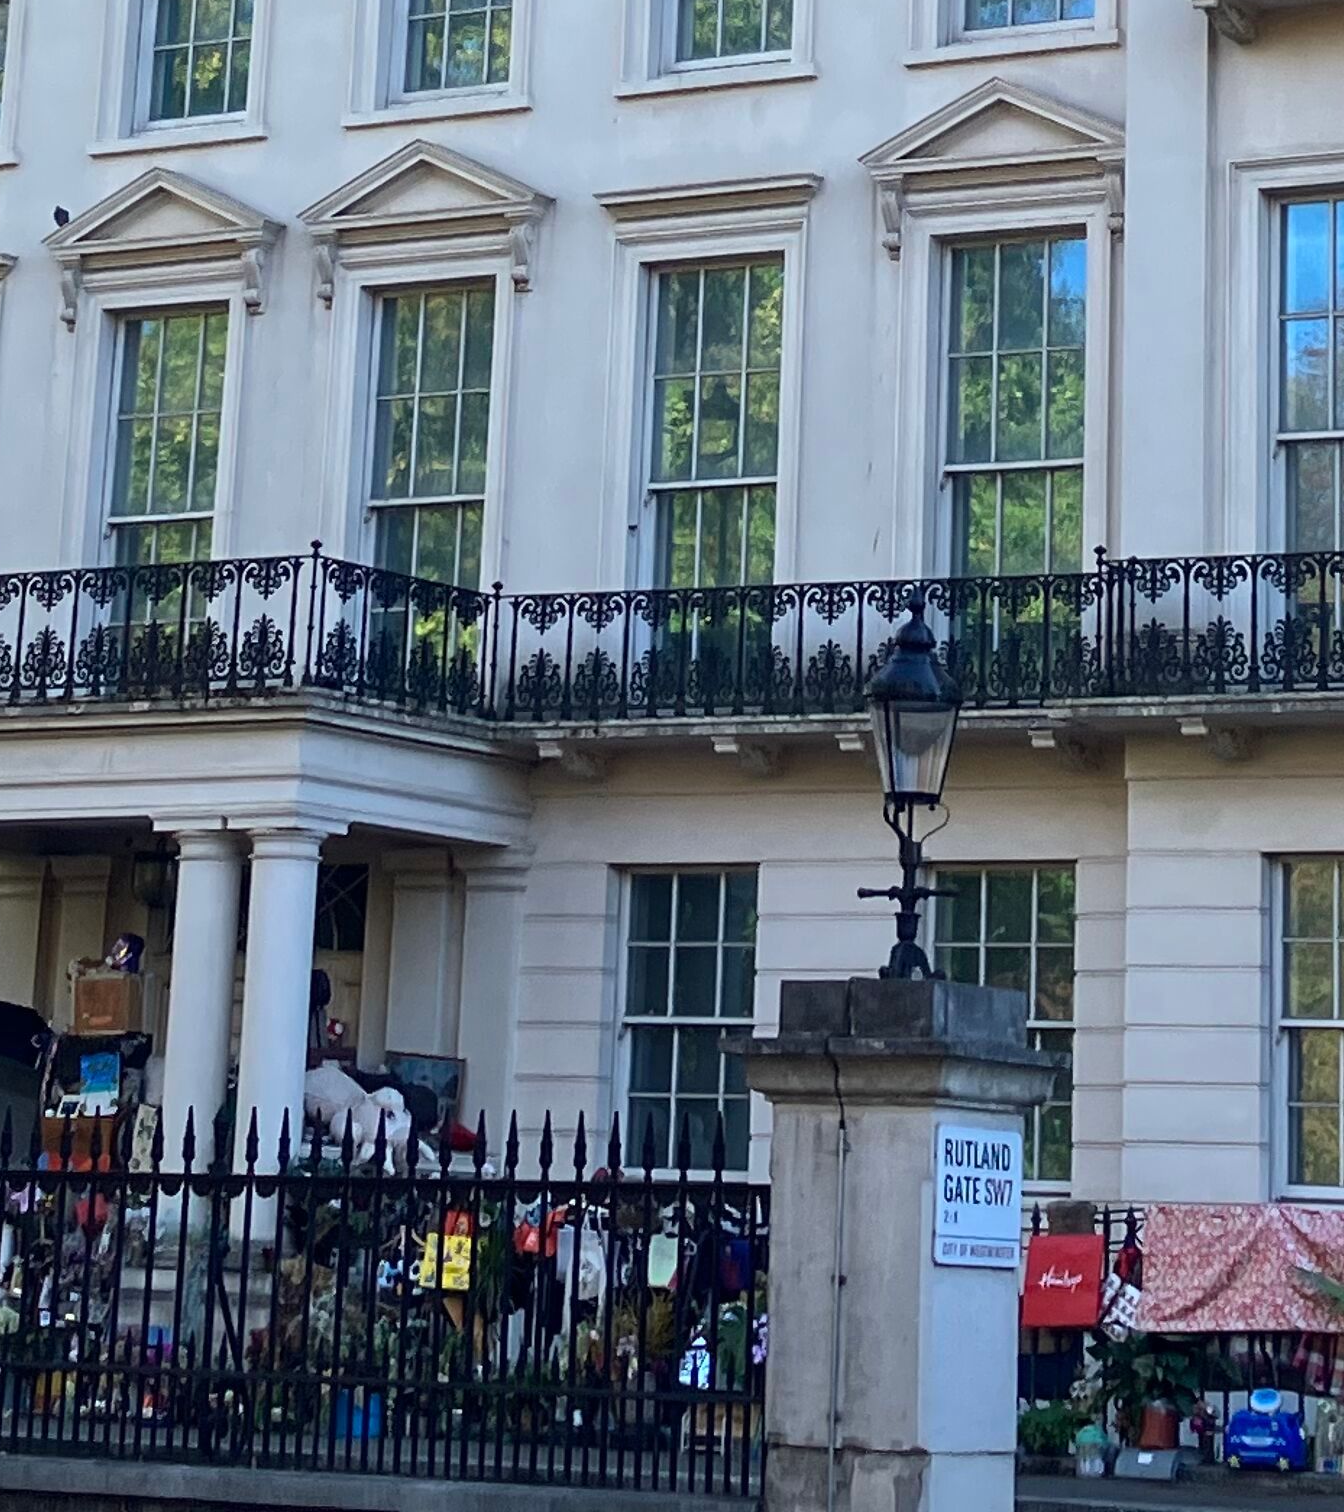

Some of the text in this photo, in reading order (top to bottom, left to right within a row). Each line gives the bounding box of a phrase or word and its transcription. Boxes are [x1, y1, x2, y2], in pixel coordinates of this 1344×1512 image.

[944, 1138, 1011, 1172] RUTLAND
[943, 1174, 1013, 1207] GATE SW7
